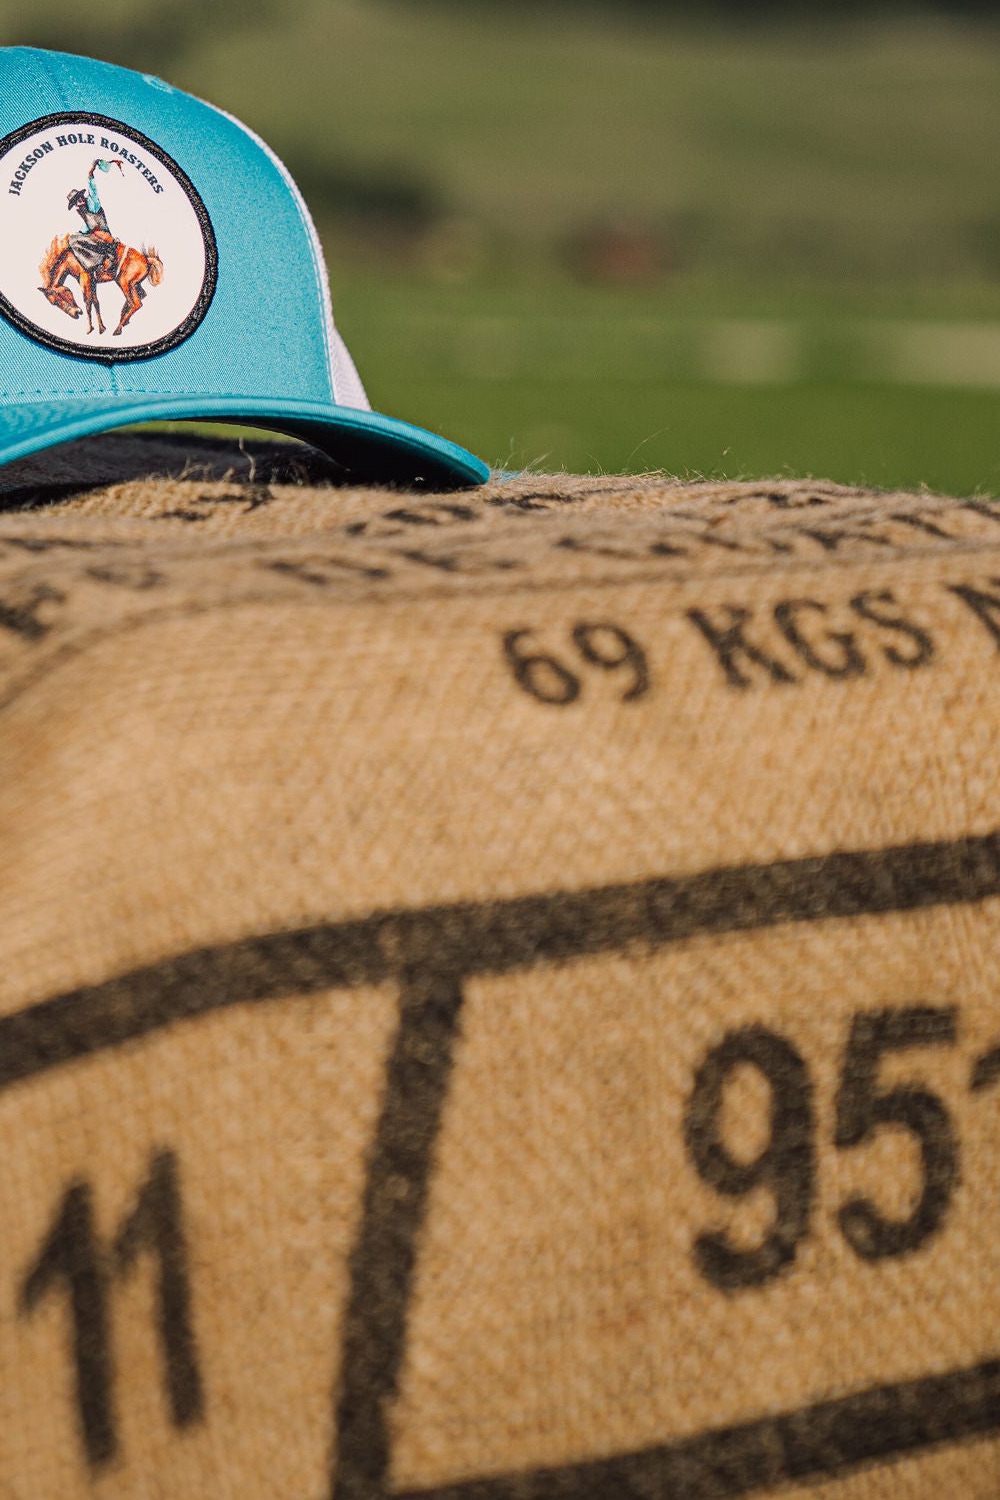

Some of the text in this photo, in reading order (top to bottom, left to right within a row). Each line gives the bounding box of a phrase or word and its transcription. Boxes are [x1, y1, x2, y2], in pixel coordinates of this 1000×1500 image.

[8, 133, 163, 196] JACKSON HOLE ROASTERS
[502, 621, 651, 704] 69
[686, 591, 935, 690] KGS
[684, 1004, 1000, 1298] 95
[16, 1144, 204, 1470] 11
